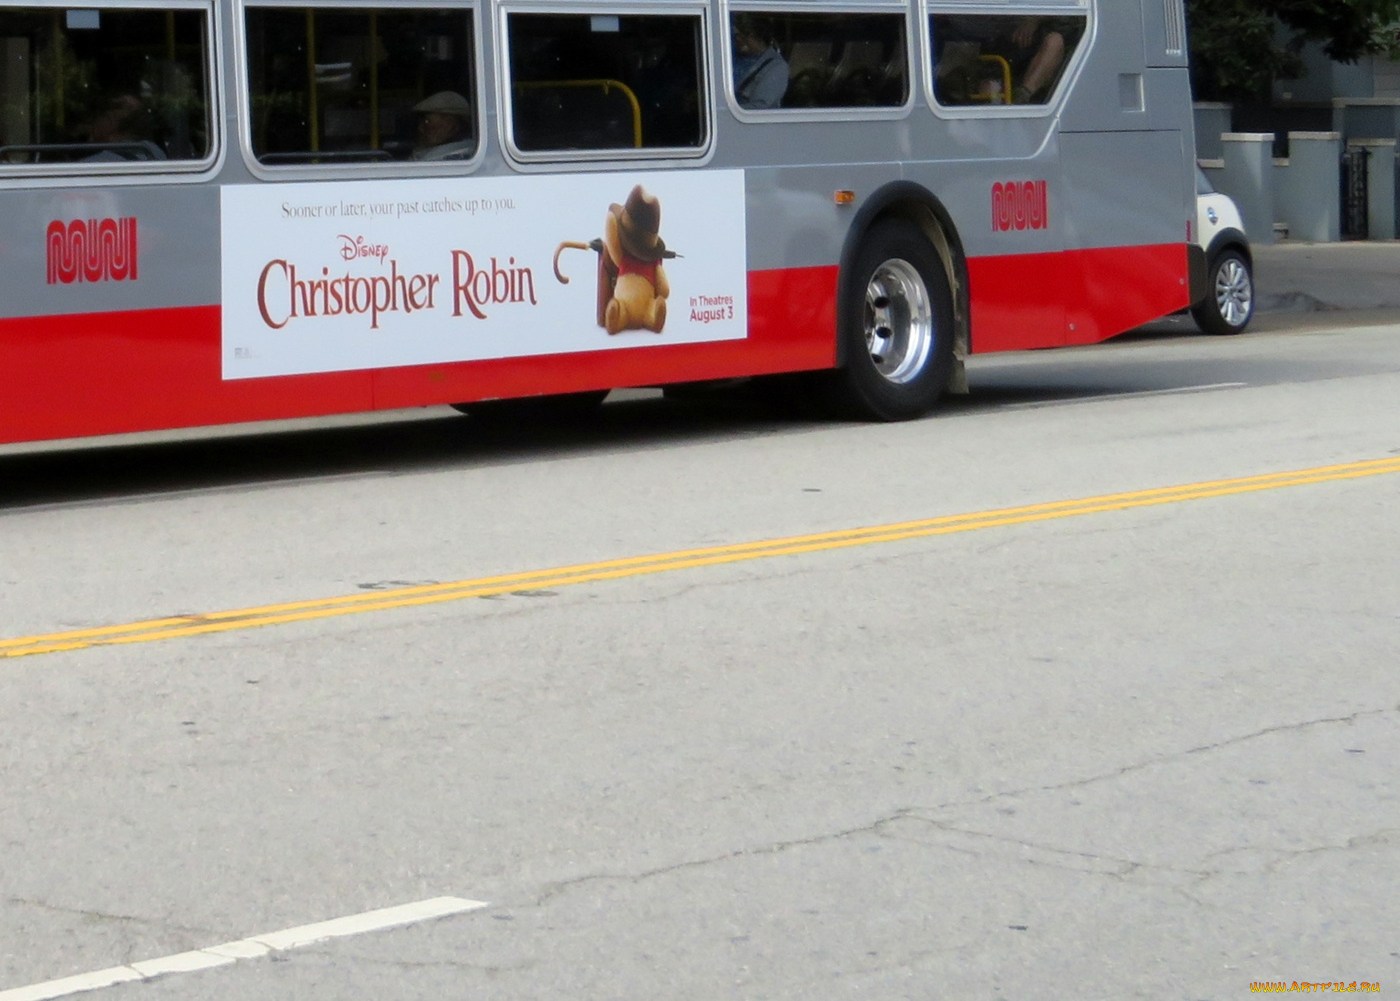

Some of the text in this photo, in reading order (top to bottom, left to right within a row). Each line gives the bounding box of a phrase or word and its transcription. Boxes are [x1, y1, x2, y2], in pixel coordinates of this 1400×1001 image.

[281, 201, 322, 218] Sooner
[325, 205, 338, 217] or
[340, 200, 368, 217] later,
[369, 203, 395, 220] your
[396, 201, 420, 220] past
[422, 197, 463, 214] catches
[464, 200, 479, 216] up
[481, 199, 493, 211] to
[256, 249, 537, 330] Christopher Robin
[689, 295, 734, 307] In Theatres
[689, 305, 734, 324] August 3
